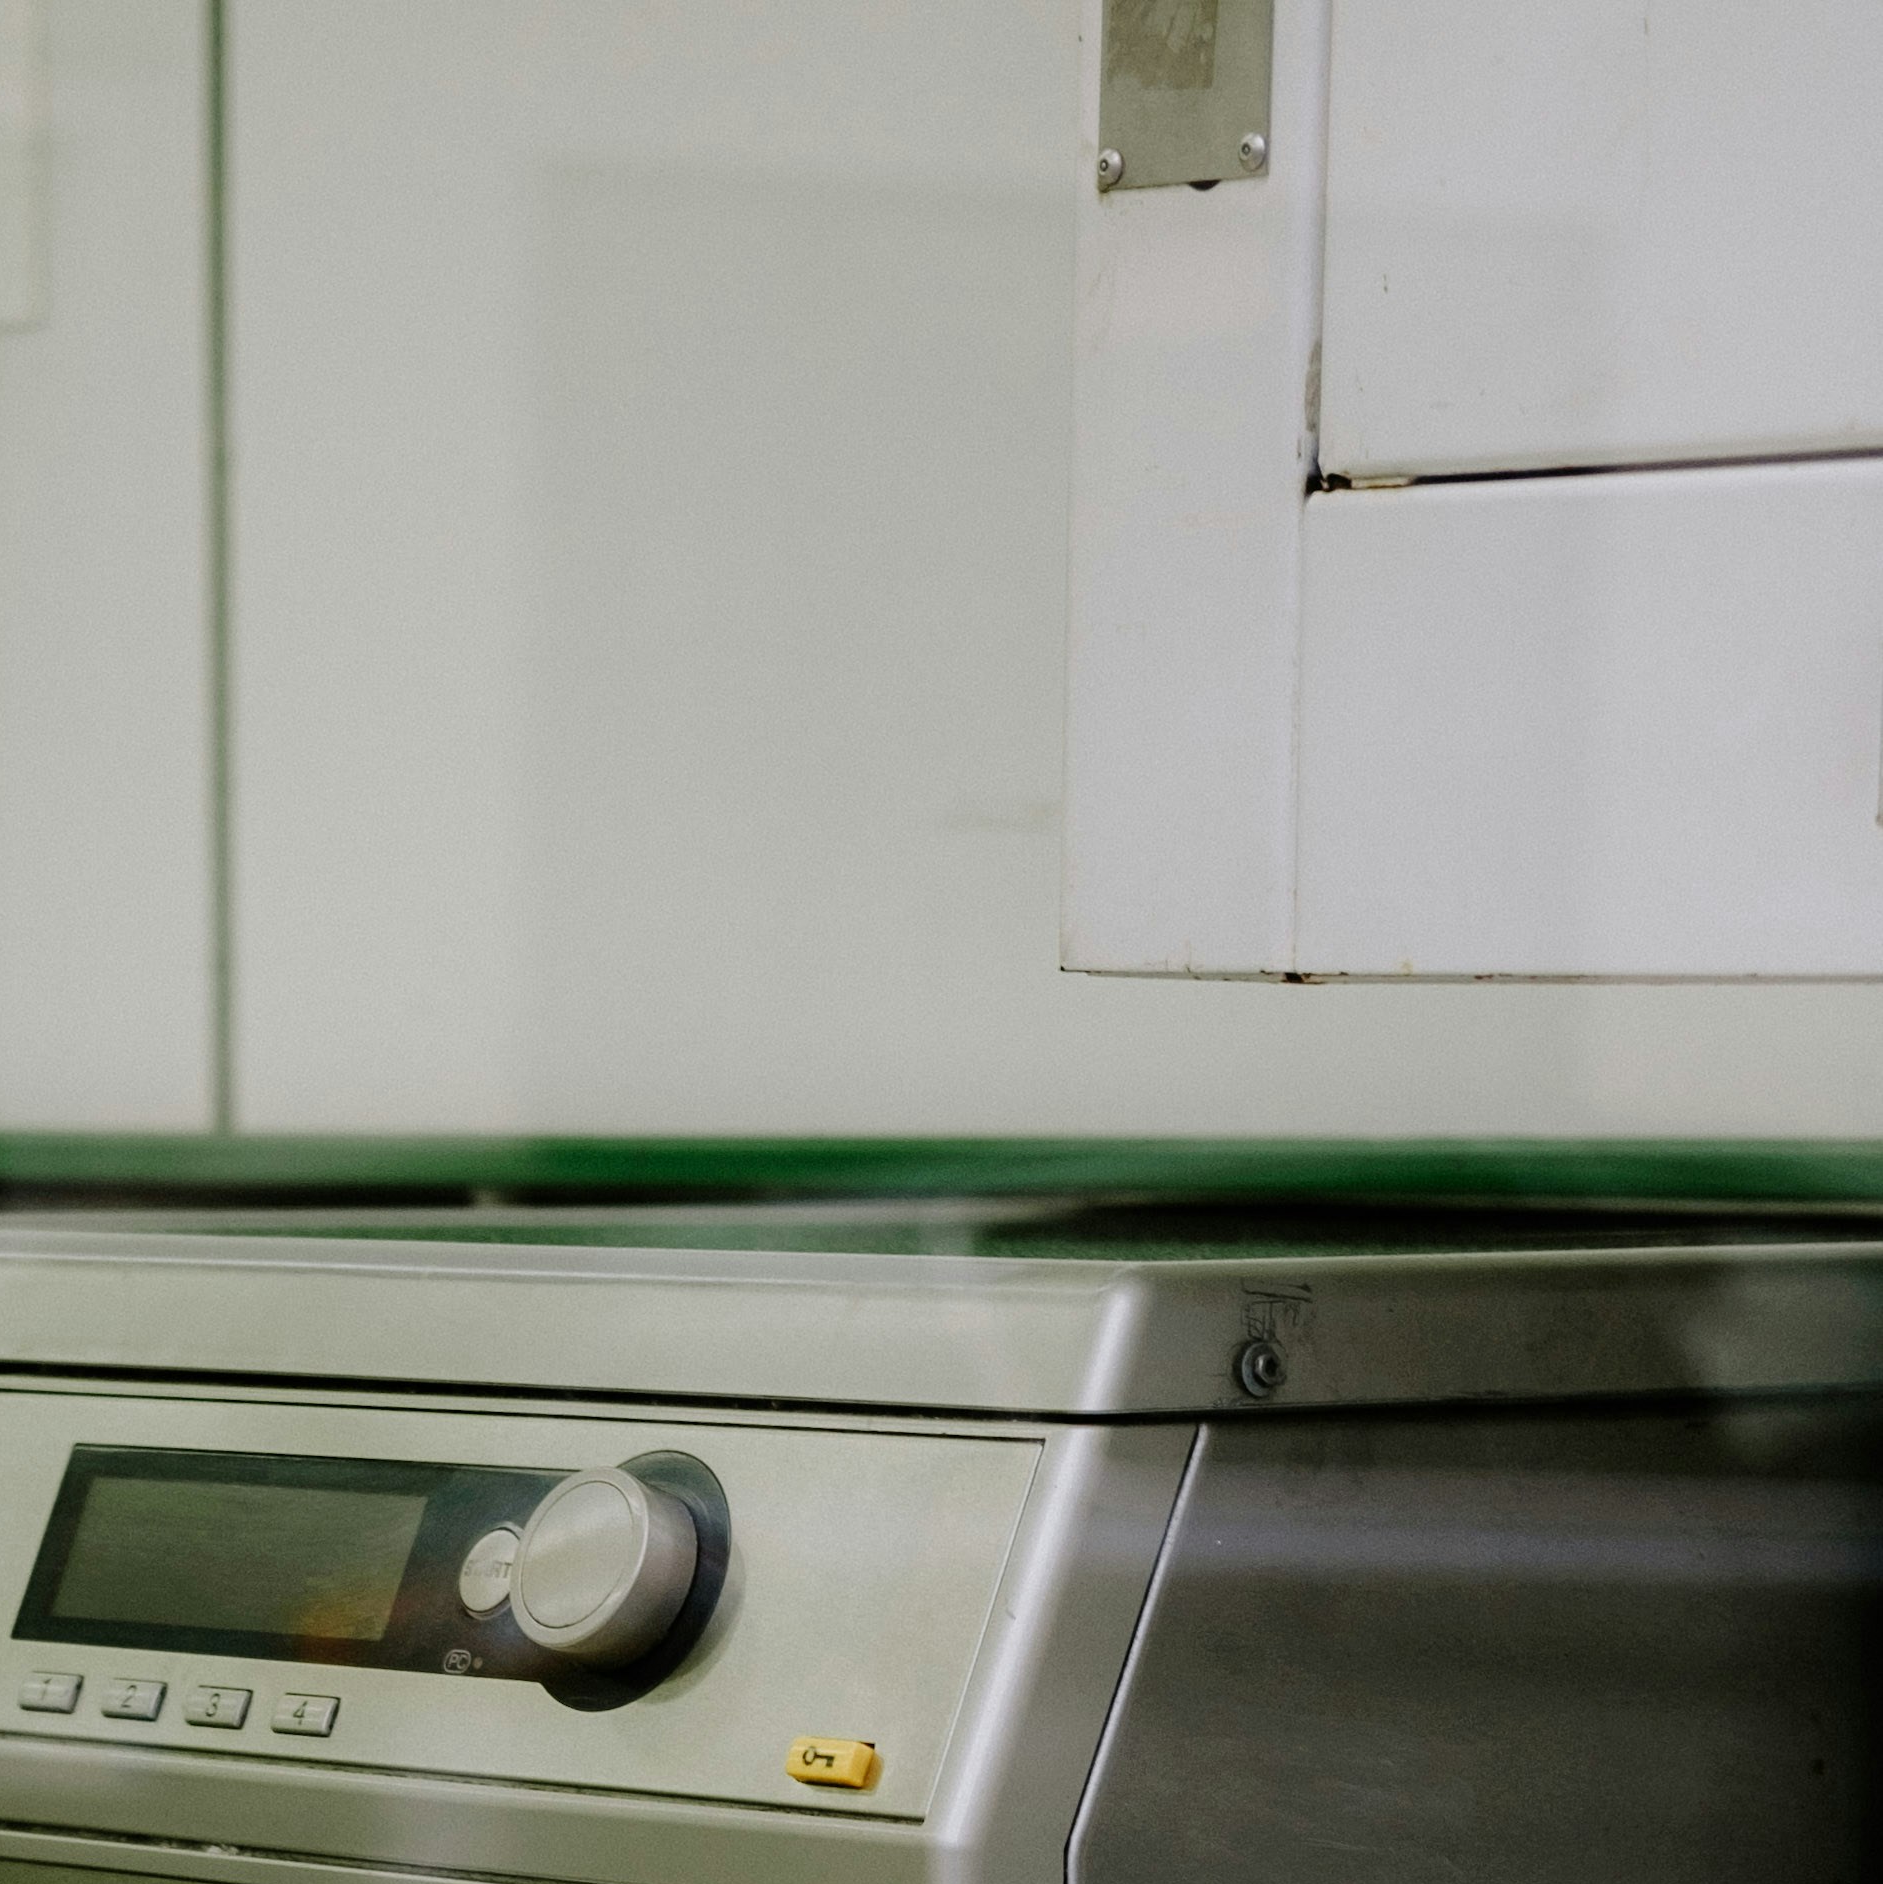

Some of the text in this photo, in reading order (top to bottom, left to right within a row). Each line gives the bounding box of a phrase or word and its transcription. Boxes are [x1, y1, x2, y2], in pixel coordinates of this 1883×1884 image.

[120, 1684, 138, 1709] 2
[204, 1692, 221, 1718] 3
[292, 1700, 308, 1726] 4
